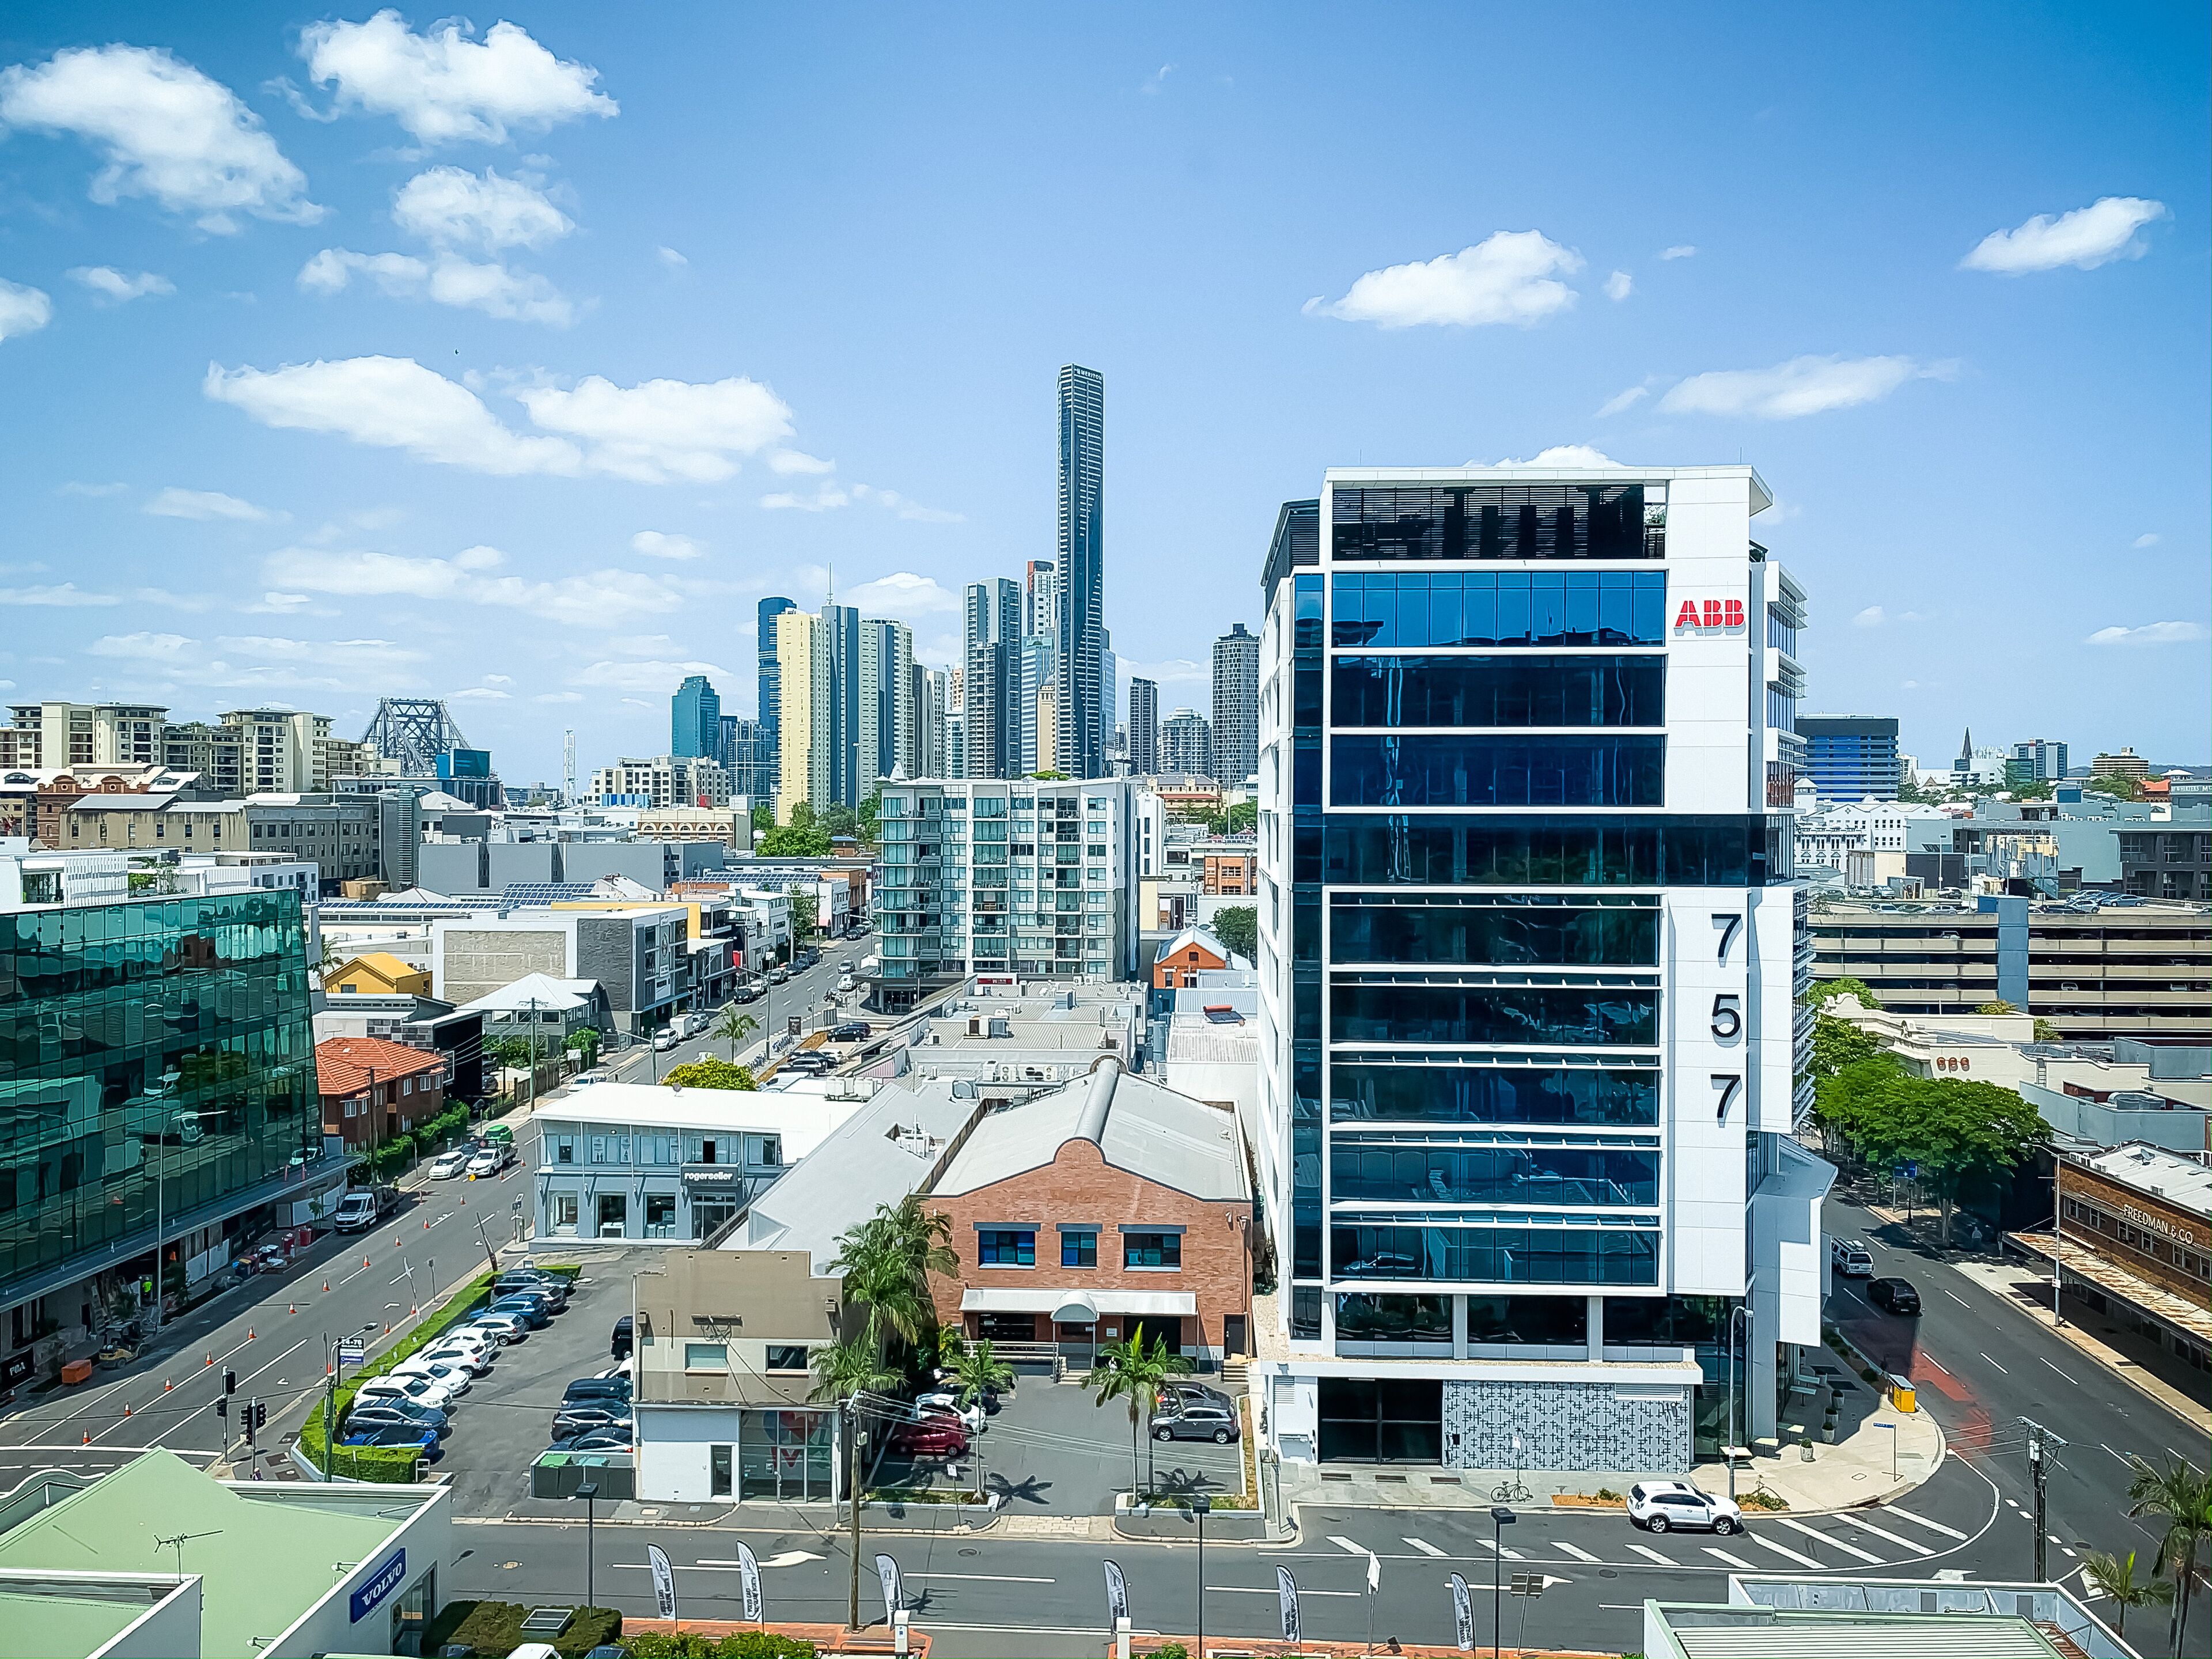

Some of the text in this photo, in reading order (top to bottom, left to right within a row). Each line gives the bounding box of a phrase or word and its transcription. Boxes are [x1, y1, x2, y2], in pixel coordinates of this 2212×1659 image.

[1675, 600, 1744, 627] ABB
[684, 1172, 733, 1181] rogerseller
[2124, 1204, 2193, 1244] FREEDMAN & CO
[362, 1563, 402, 1606] VOLVO
